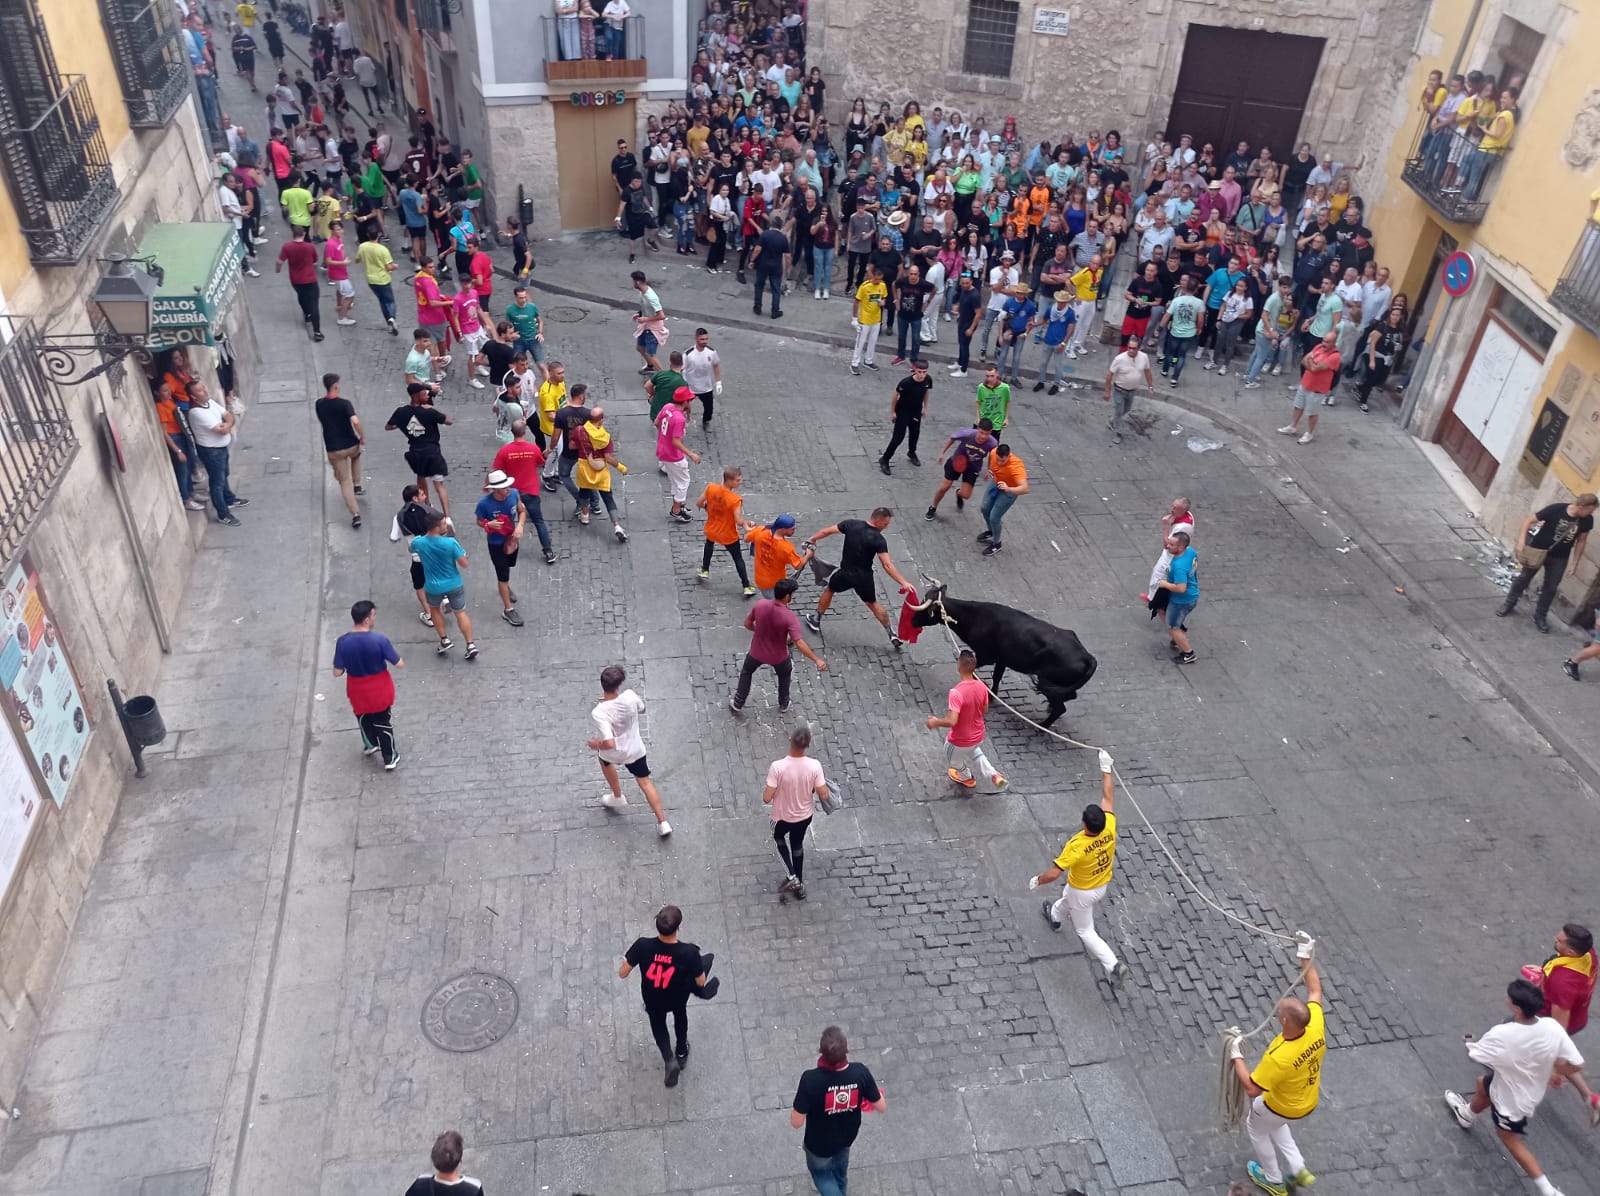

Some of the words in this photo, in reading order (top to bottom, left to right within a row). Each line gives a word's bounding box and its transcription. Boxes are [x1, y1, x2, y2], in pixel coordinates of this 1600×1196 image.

[205, 231, 240, 303] COMESTIBLE
[153, 300, 197, 311] GALOS
[153, 311, 209, 324] OGUERÍA
[1539, 412, 1565, 462] infotur
[645, 962, 676, 990] 41
